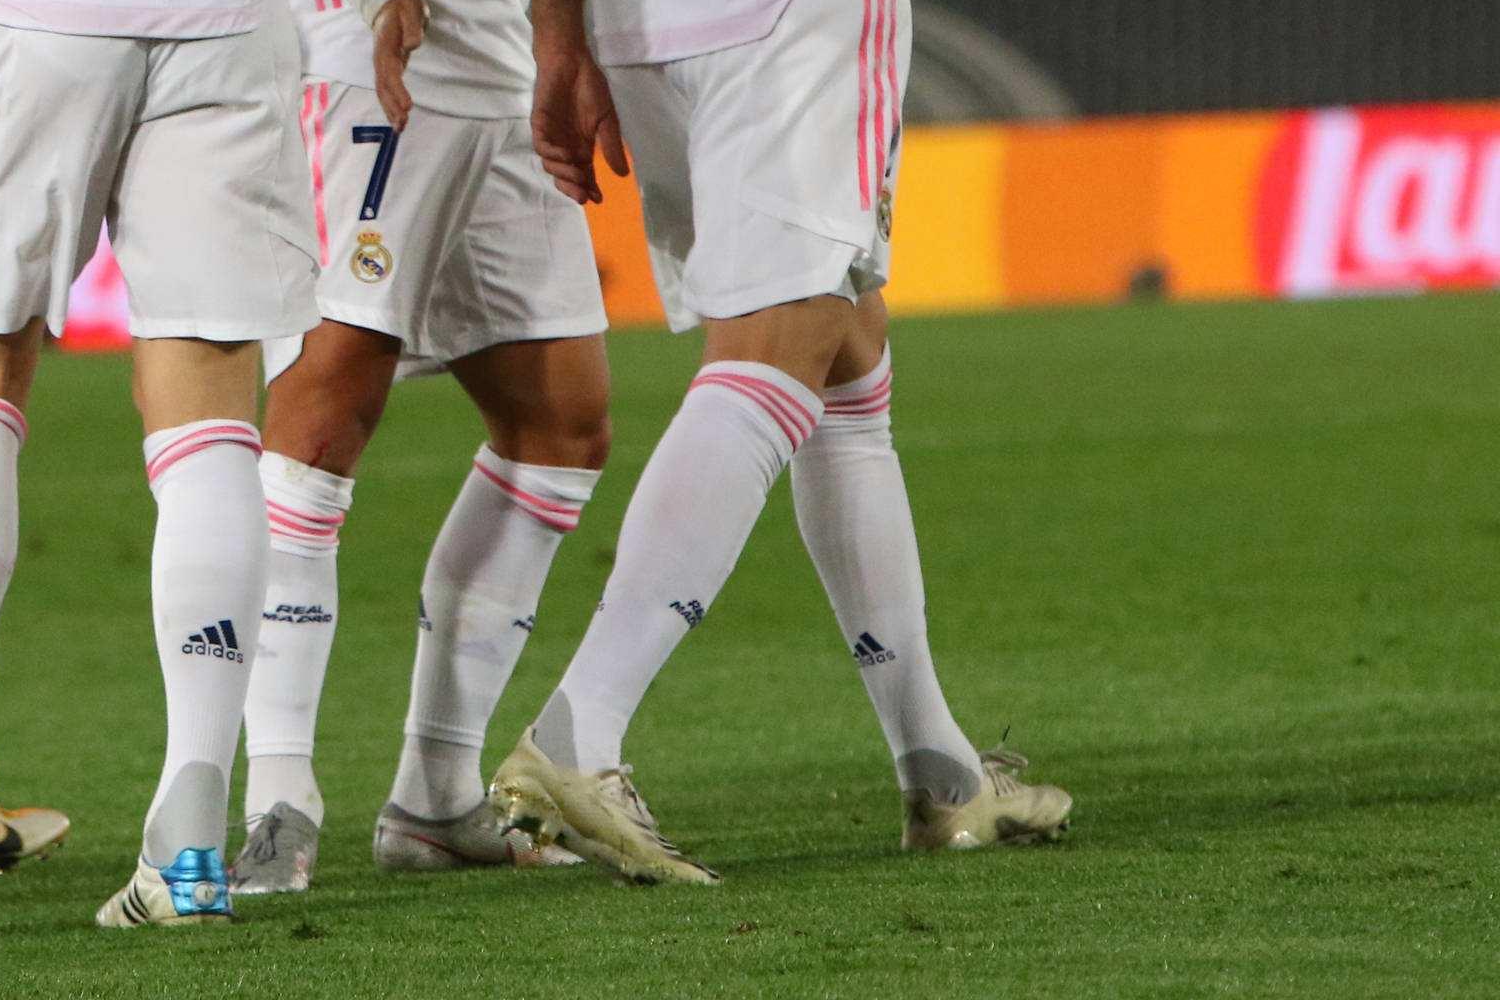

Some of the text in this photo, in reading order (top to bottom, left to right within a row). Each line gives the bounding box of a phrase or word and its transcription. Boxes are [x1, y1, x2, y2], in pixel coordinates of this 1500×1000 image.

[352, 126, 398, 220] 7
[276, 605, 323, 614] REAL
[182, 642, 243, 663] adidas
